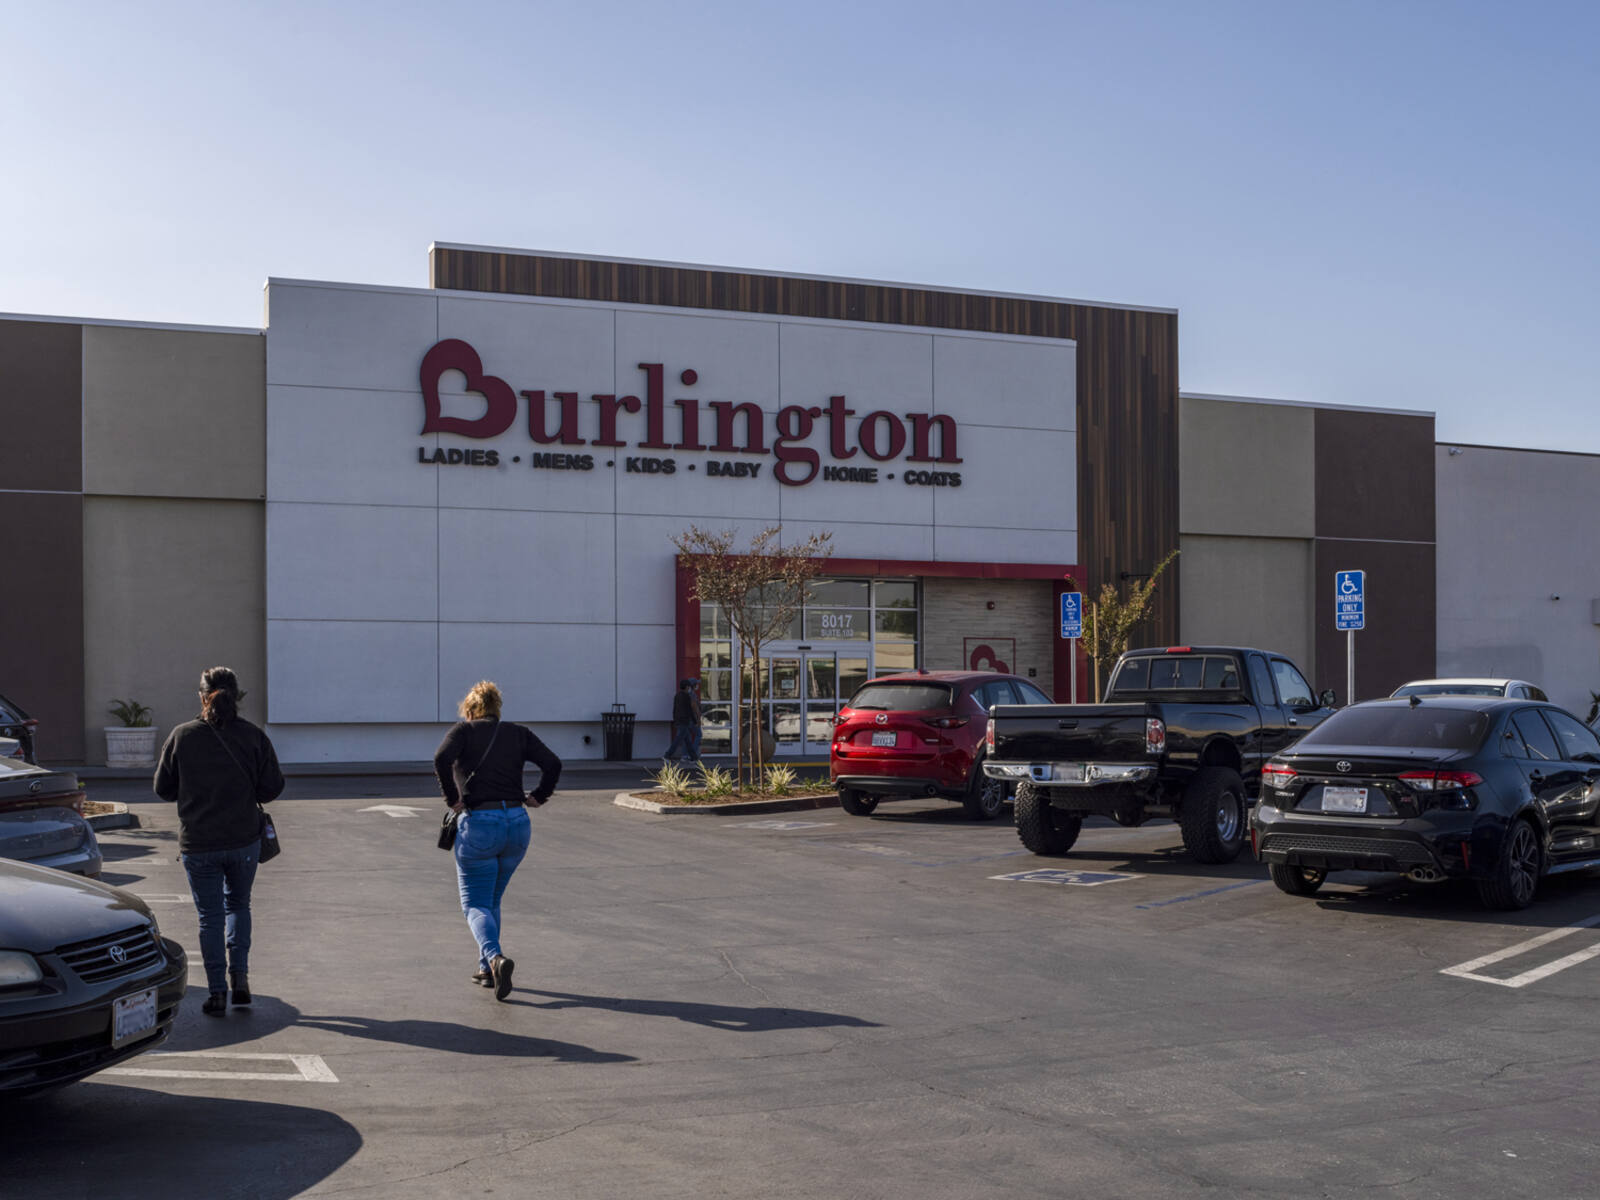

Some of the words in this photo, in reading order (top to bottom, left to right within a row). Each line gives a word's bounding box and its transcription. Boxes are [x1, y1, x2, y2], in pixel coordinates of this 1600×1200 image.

[419, 338, 963, 486] Burlington
[418, 447, 499, 466] LADIES
[533, 452, 594, 471] MENS
[626, 457, 676, 474] KIDS
[707, 461, 761, 478] BABY
[824, 466, 878, 483] HOME
[904, 470, 962, 487] COATS
[1338, 594, 1362, 603] PARKING
[1342, 604, 1358, 612] ONLY
[822, 614, 852, 628] 8017
[820, 629, 841, 637] SUITE
